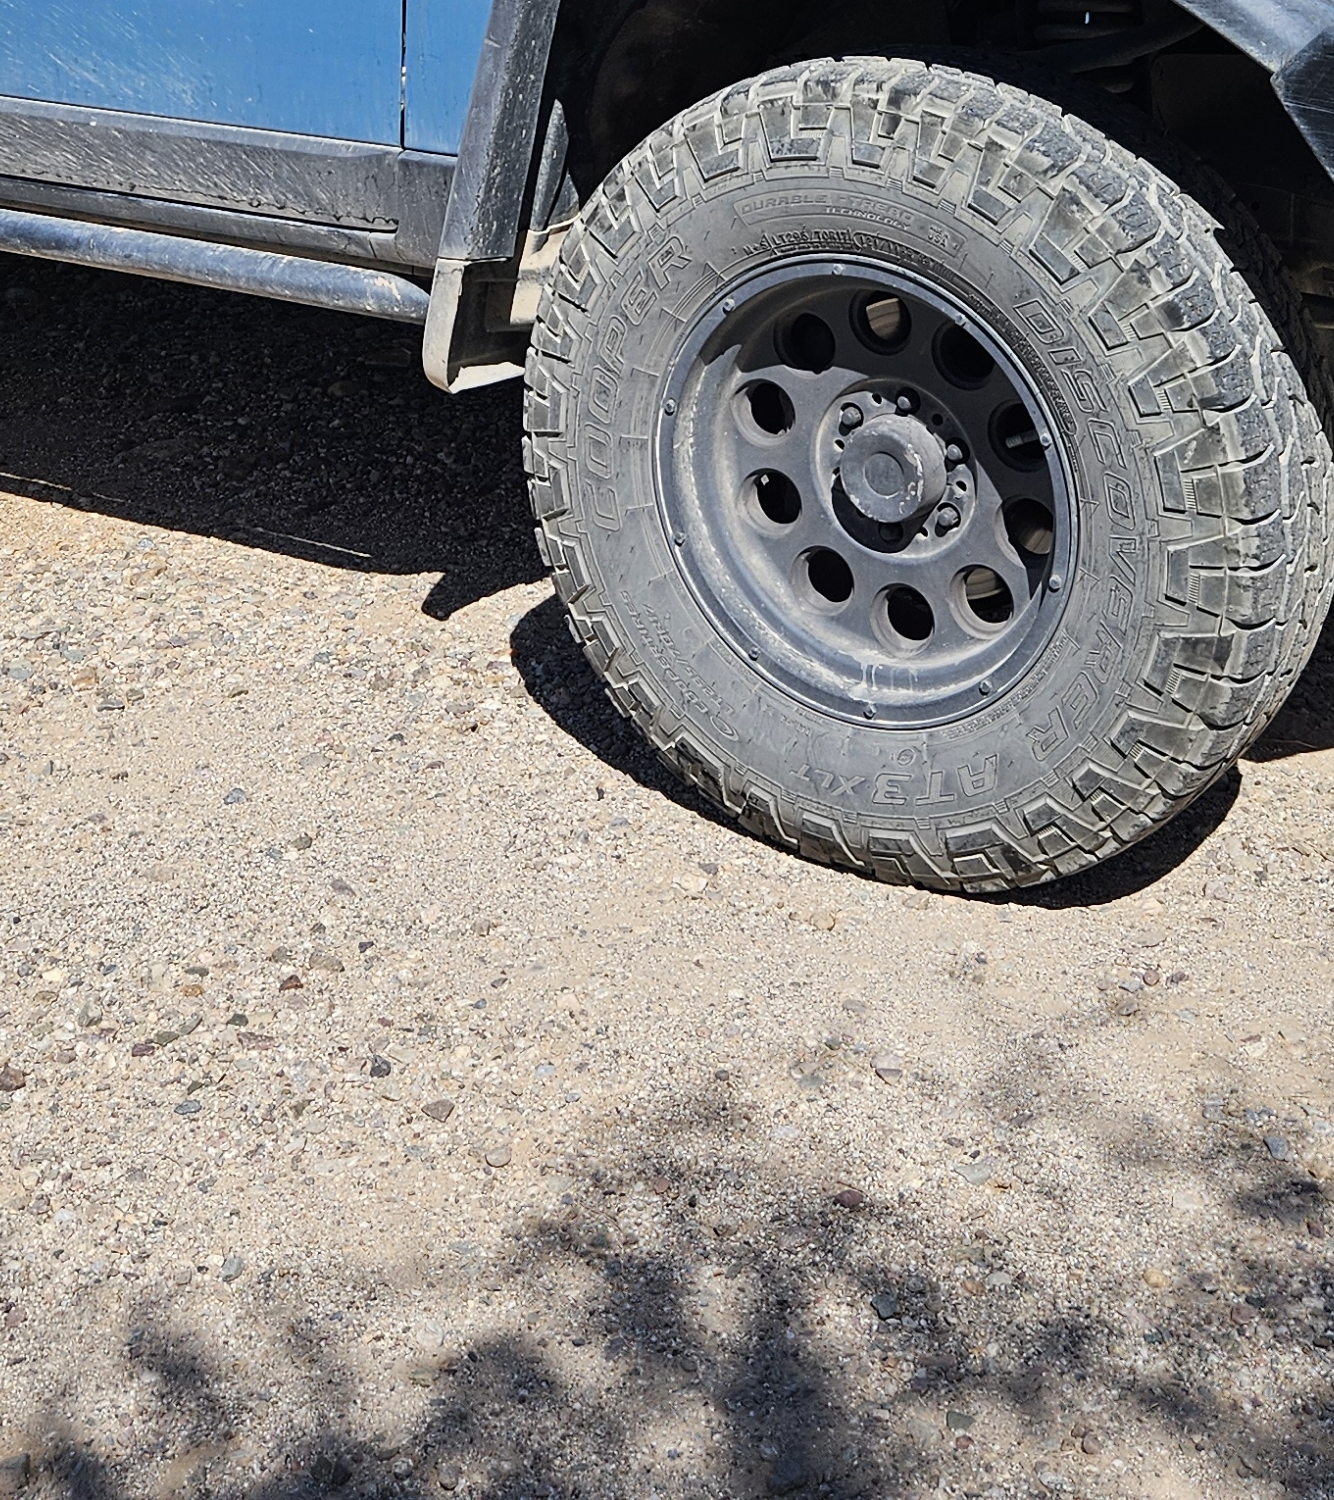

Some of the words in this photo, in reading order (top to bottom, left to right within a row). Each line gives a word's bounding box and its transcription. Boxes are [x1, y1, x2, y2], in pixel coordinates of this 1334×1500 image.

[825, 206, 910, 231] TECHNOLOGY
[928, 232, 950, 248] USA
[585, 235, 692, 532] COOPER
[1012, 298, 1137, 762] DISCOVERER
[642, 603, 734, 716] LT295/70R17
[789, 762, 865, 797] XLT
[871, 752, 999, 806] AT3
